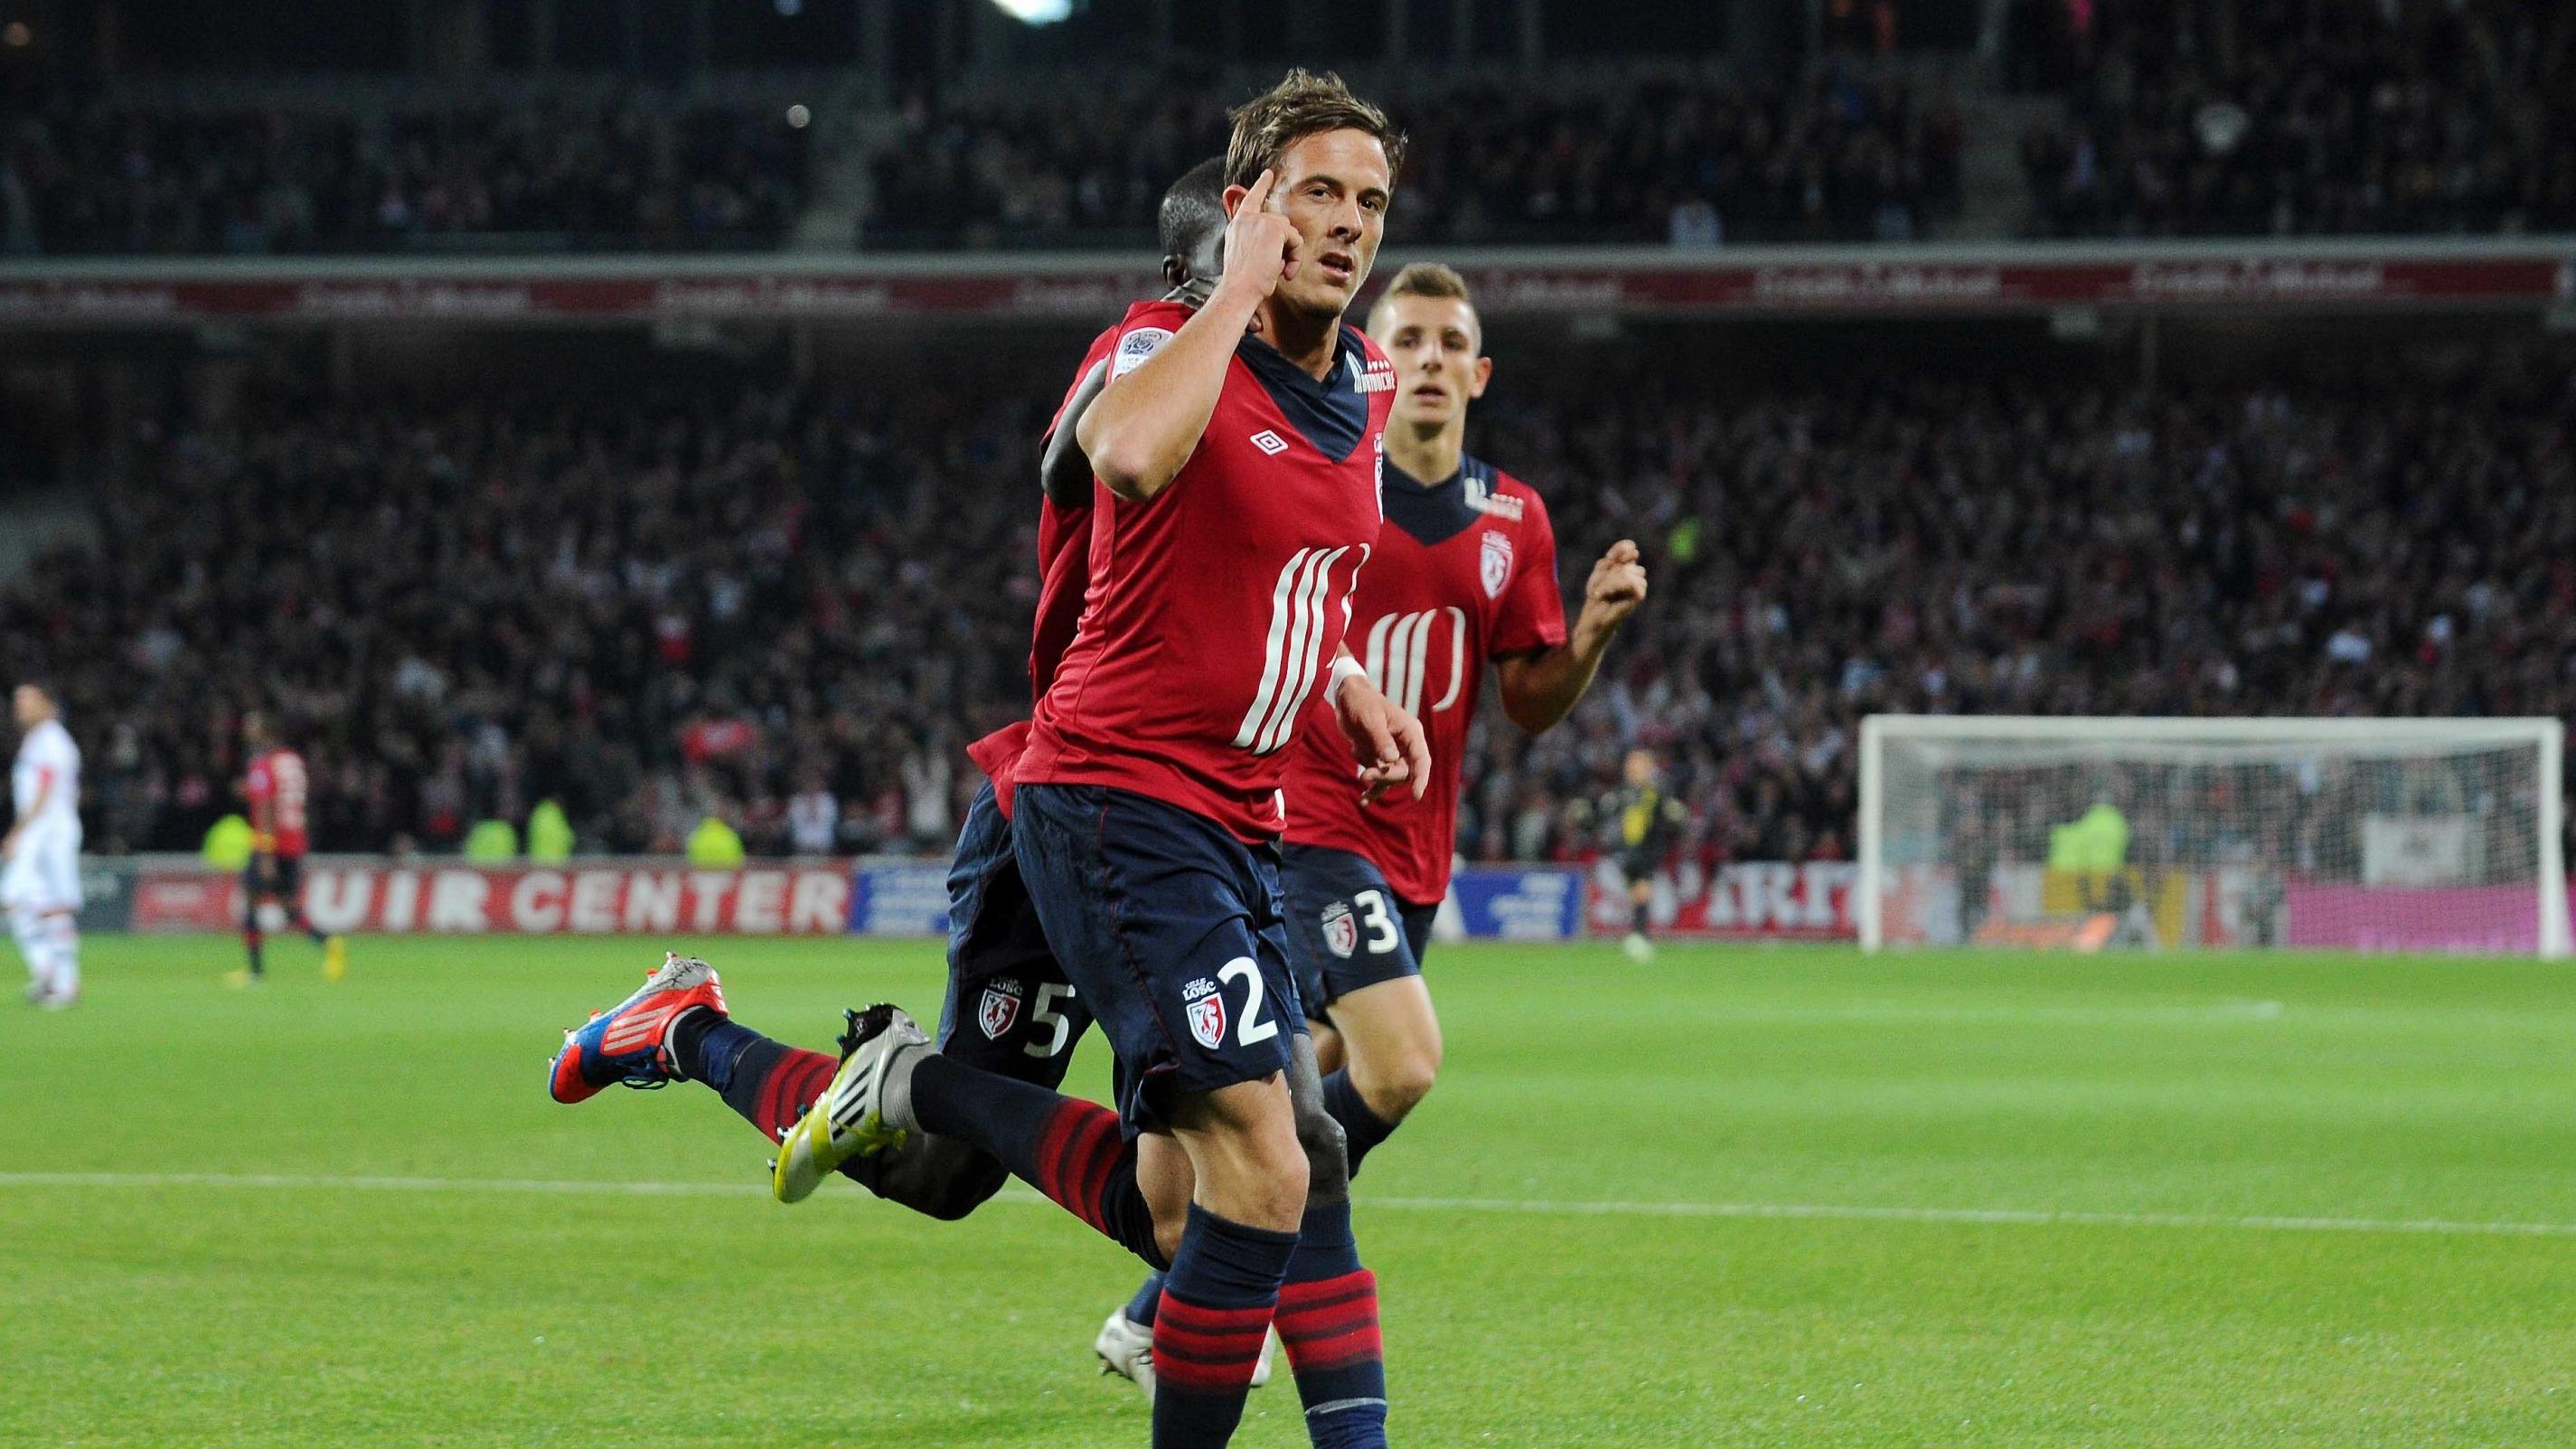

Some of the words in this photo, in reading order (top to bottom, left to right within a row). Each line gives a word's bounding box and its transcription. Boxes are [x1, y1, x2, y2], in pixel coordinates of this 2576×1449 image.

[512, 870, 848, 934] CENTER
[1355, 889, 1400, 955] 3
[1023, 983, 1076, 1059] 5
[1217, 955, 1280, 1048] 2
